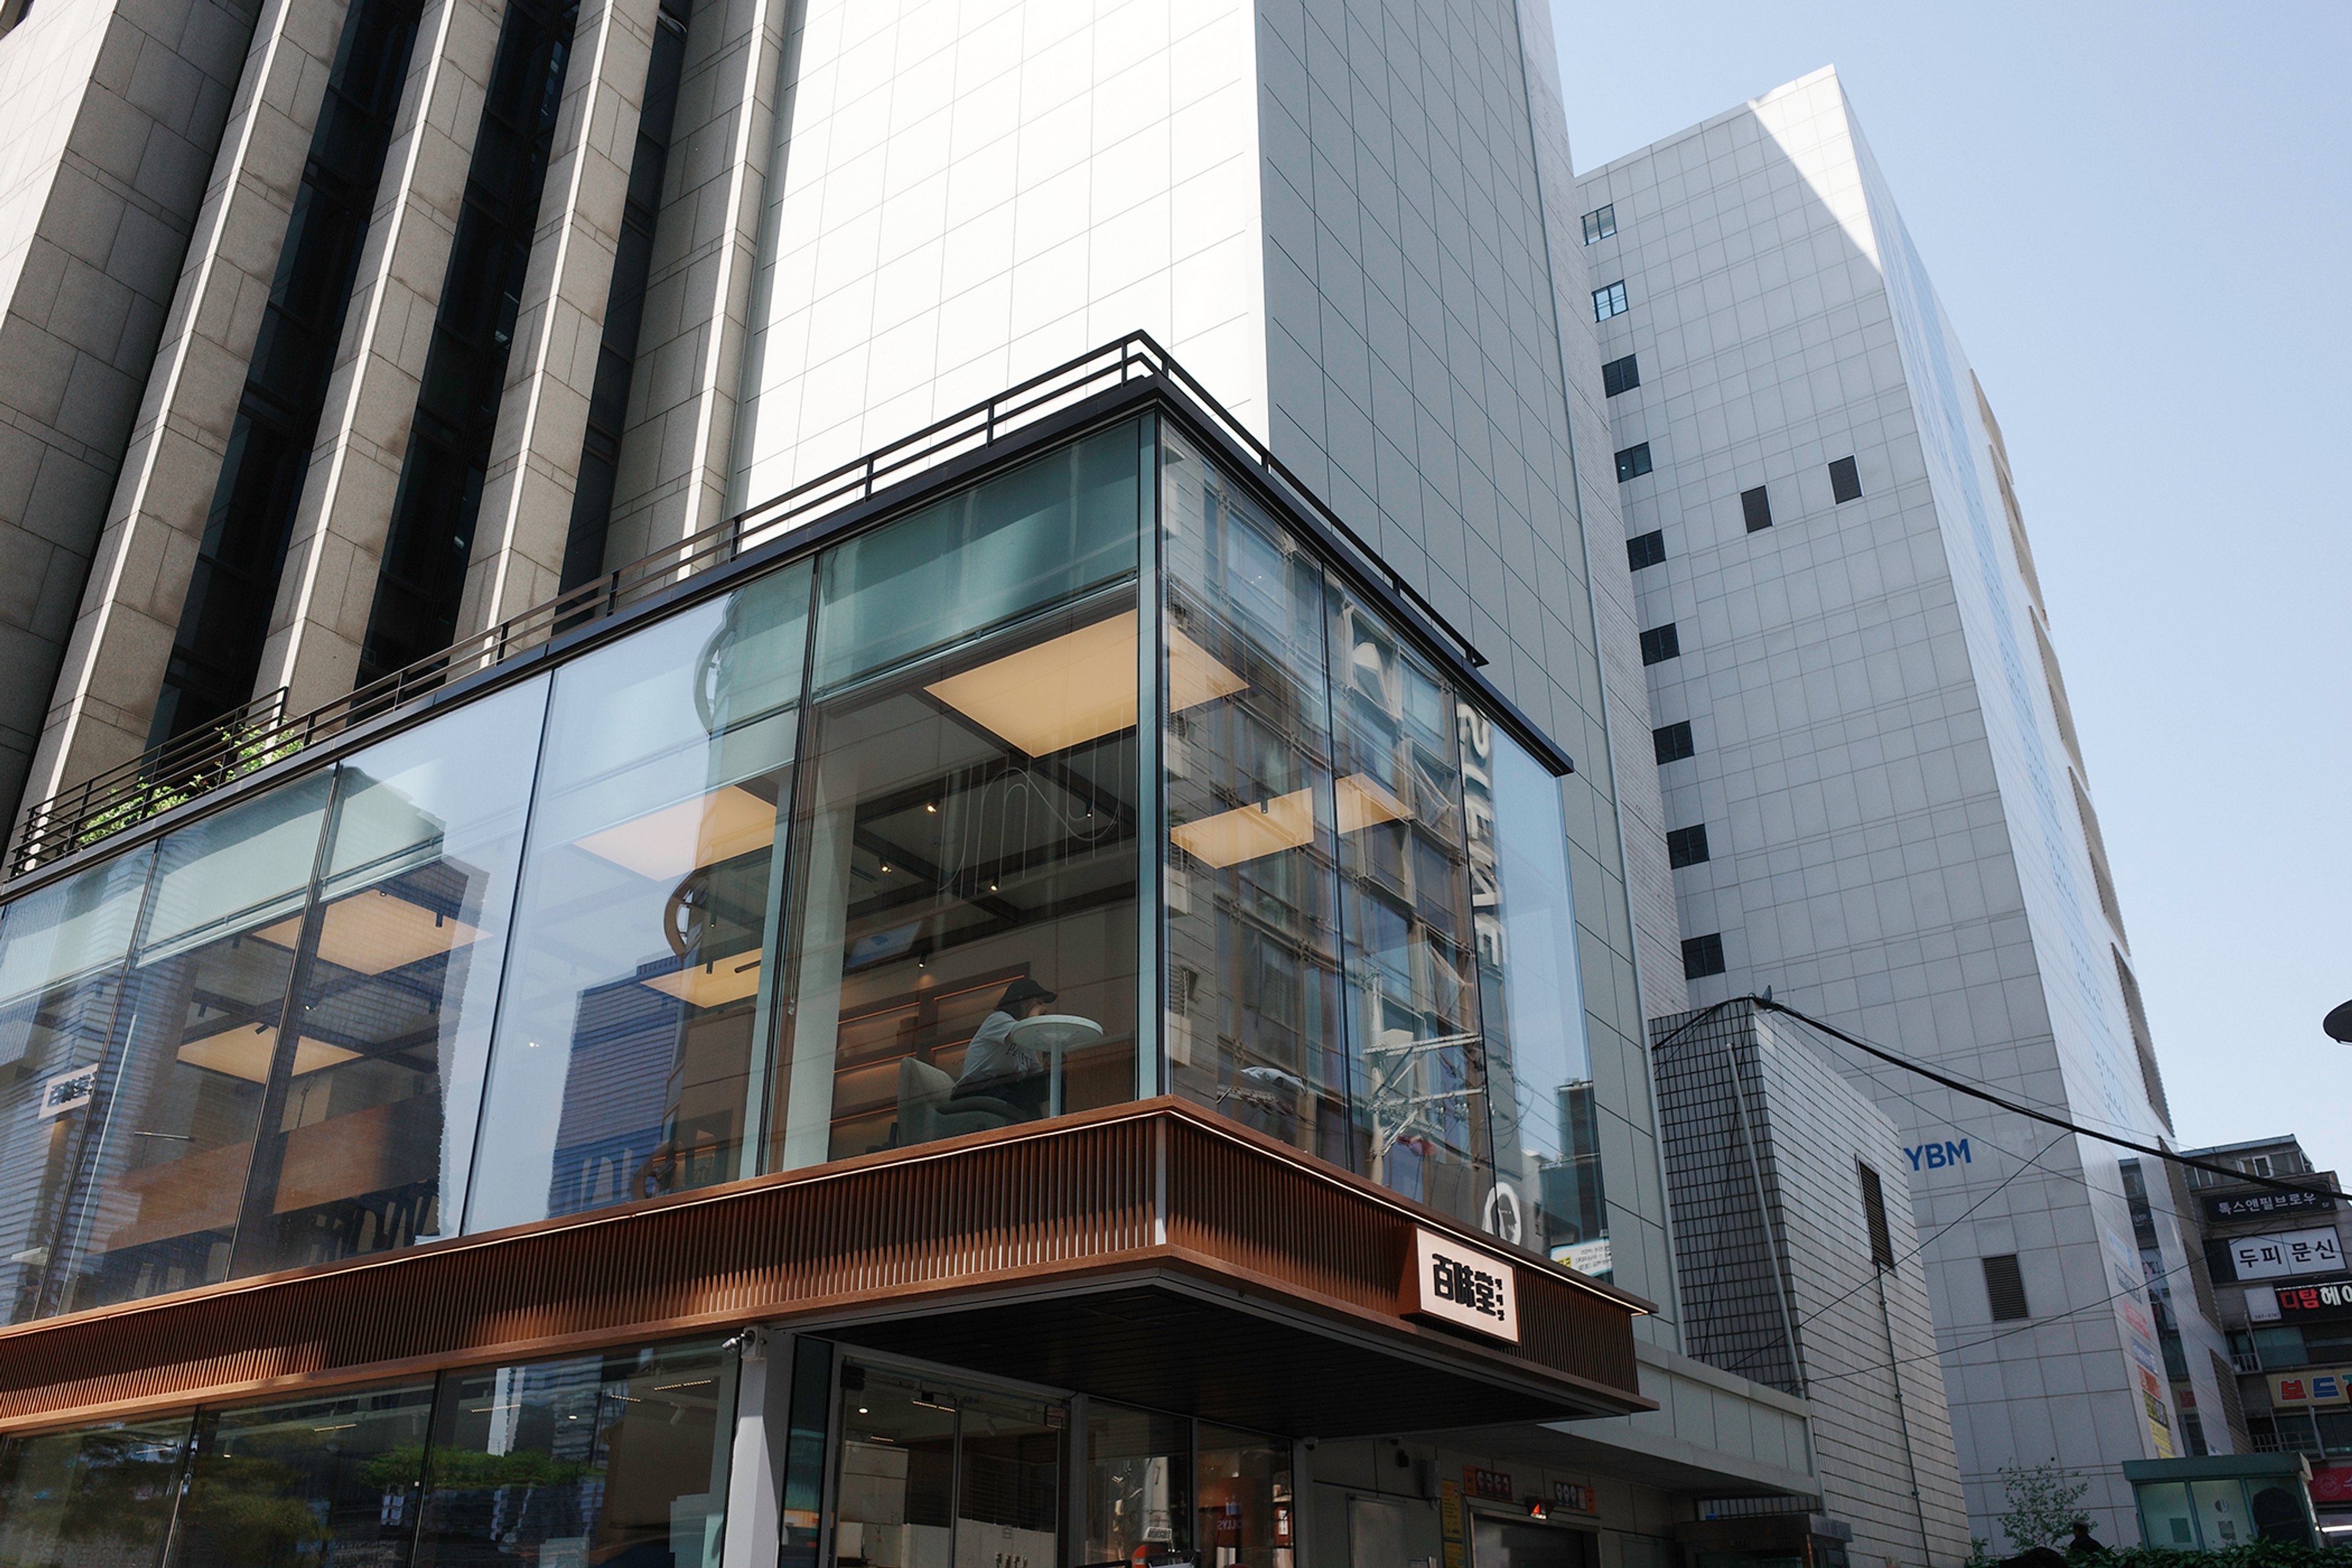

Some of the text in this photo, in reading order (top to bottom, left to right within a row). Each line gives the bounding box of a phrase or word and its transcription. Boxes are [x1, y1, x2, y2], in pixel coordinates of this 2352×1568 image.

[1903, 1138, 1972, 1171] YBM
[2239, 1238, 2337, 1268] 두피 문신
[2279, 1373, 2352, 1402] 보드
